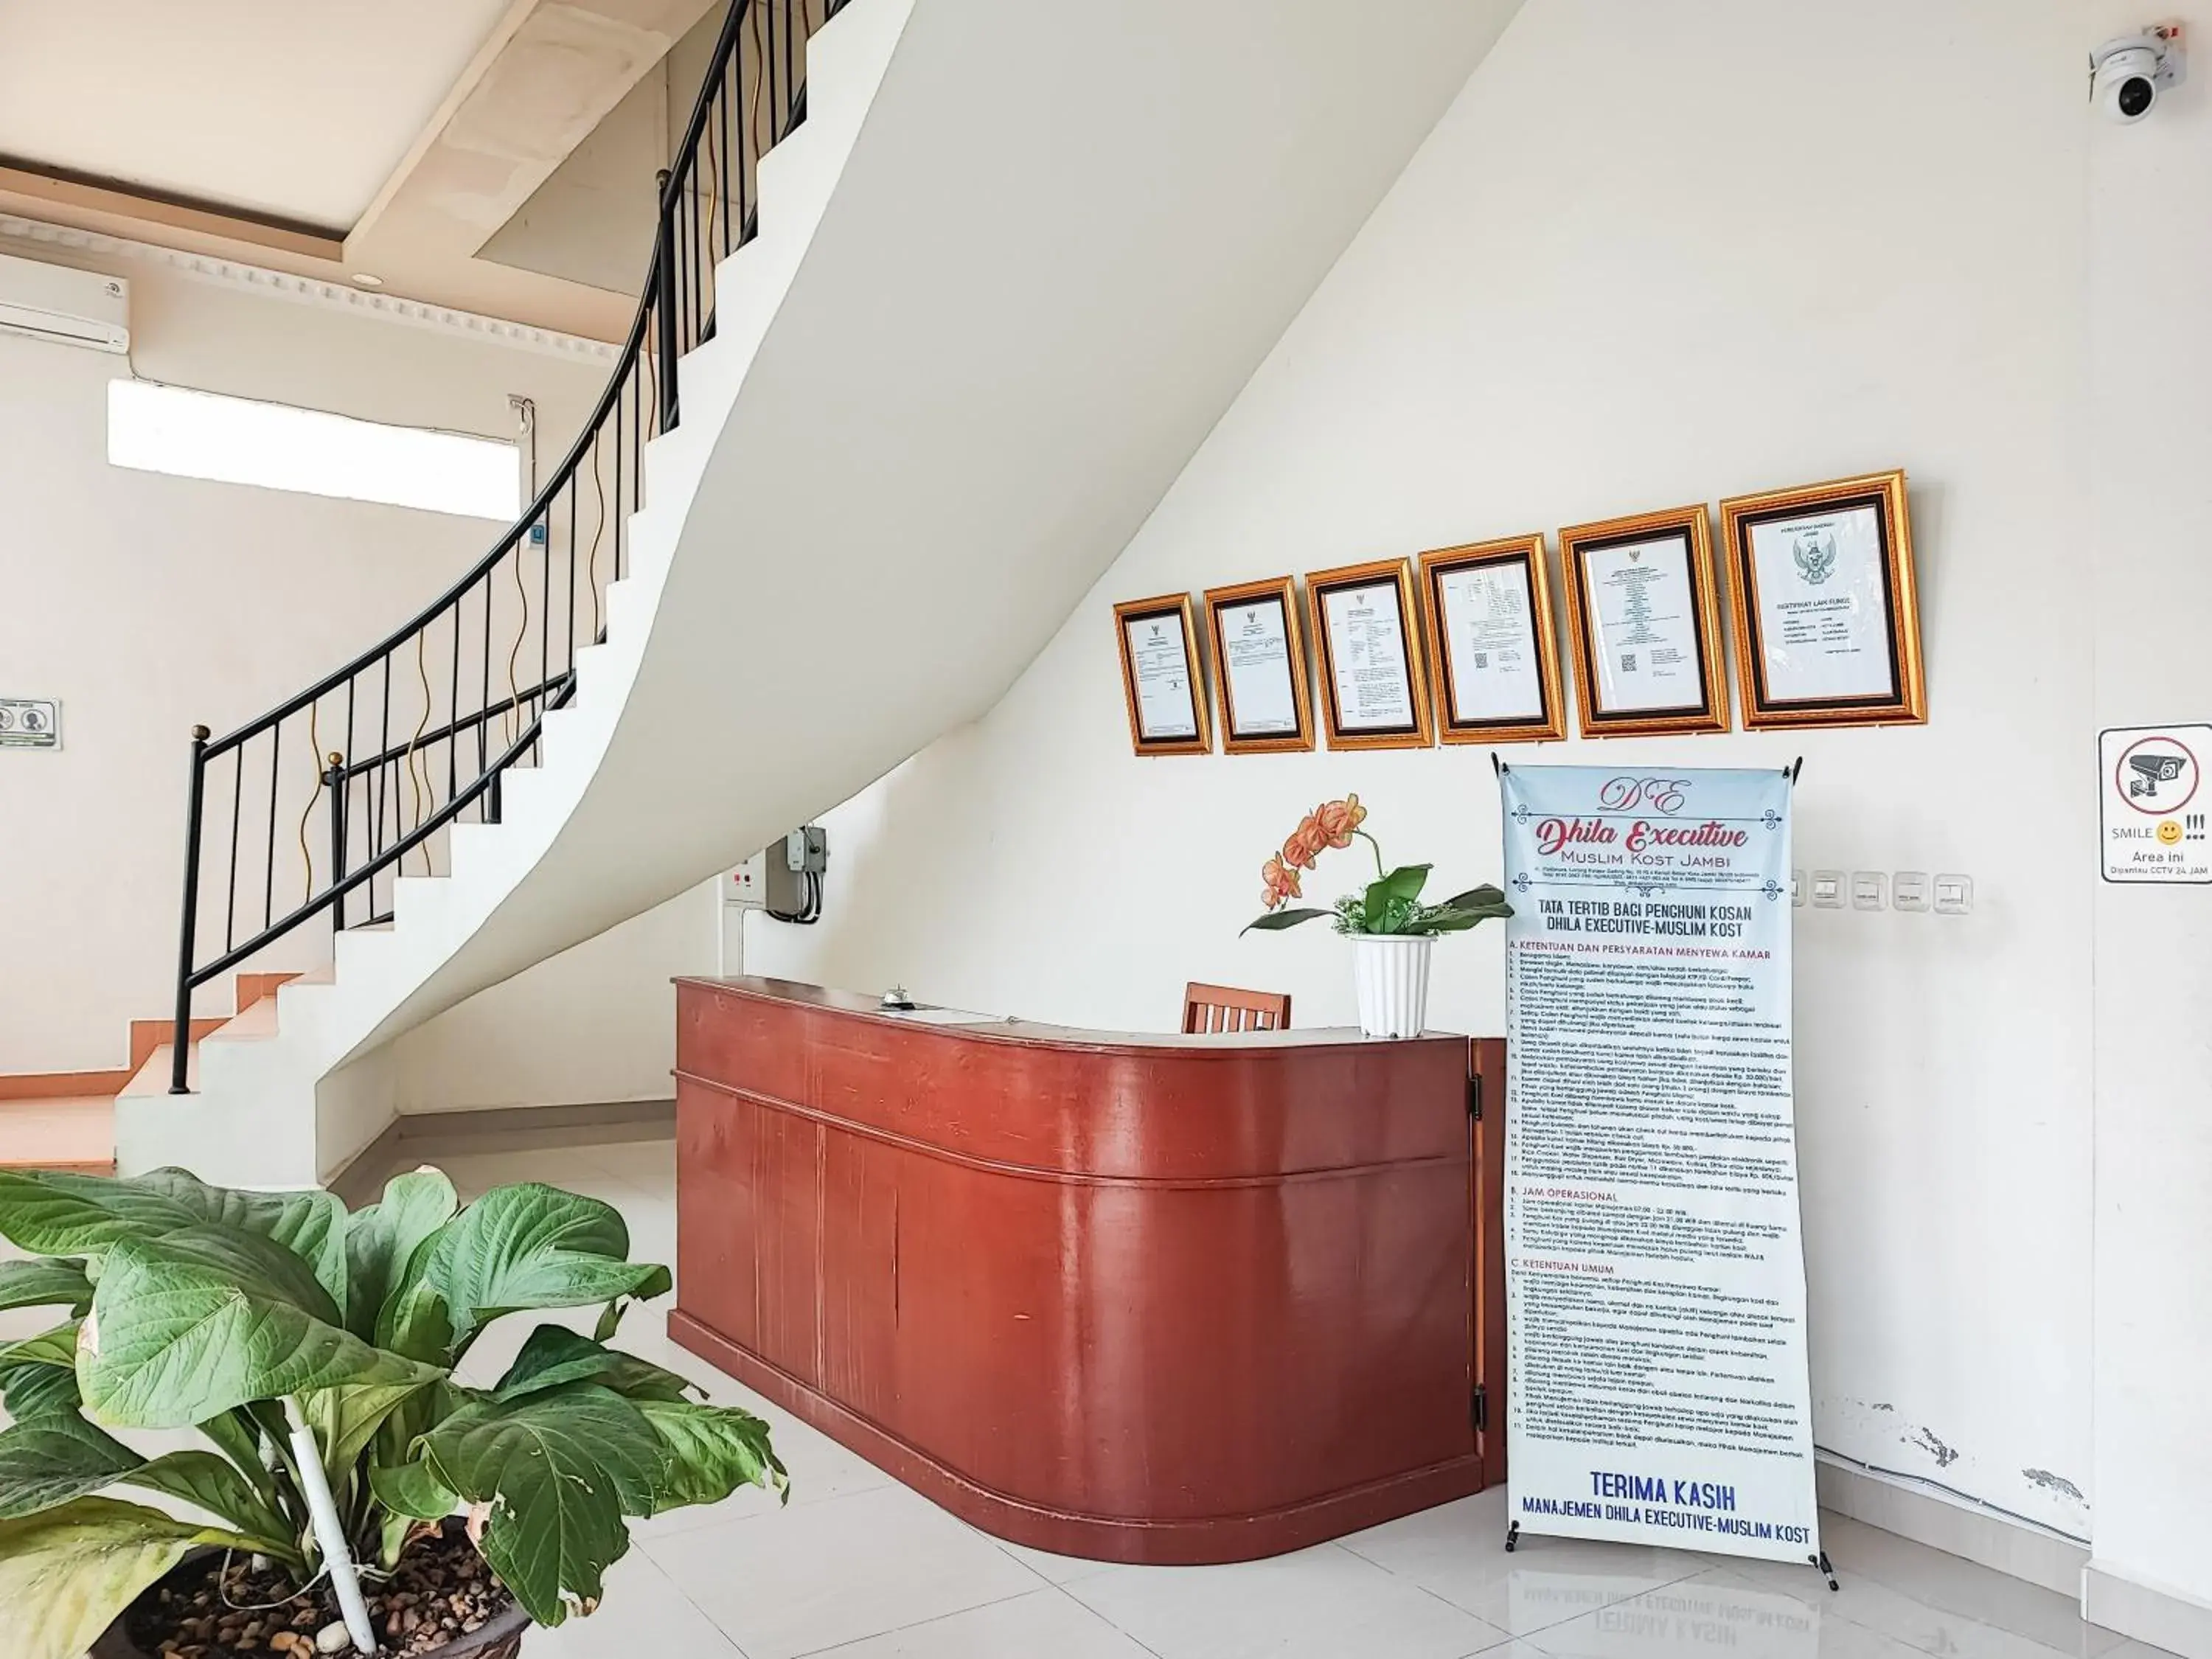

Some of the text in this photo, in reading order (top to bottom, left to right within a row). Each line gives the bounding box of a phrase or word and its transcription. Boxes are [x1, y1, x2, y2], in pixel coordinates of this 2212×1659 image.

[1536, 818, 1748, 855] Dhila Executive
[2112, 828, 2153, 838] SMILE
[1561, 851, 1730, 868] MUSLIM KOST JAMBI
[2133, 851, 2183, 862] Area ini
[2150, 866, 2172, 874] CCTV
[1540, 900, 1752, 921] TATA TERTIB BAGI PENGHUNI KOSAN
[1547, 917, 1743, 937] DHILA EXECUTIVE-MUSLIM KOST
[1510, 941, 1770, 959] A. KETENTUAN DAN PERSYARATAN MENYEWA KAMAR
[1523, 1187, 1544, 1196] JAM
[1547, 1189, 1617, 1202] OPERASIONAL
[1523, 1259, 1577, 1270] KETENTUAN
[1582, 1263, 1614, 1273] UMUM
[1590, 1470, 1735, 1512] TERIMA KASIH
[1523, 1495, 1809, 1544] MANAJEMEN DHILA EXECUTIVE-MUSLIM KOST
